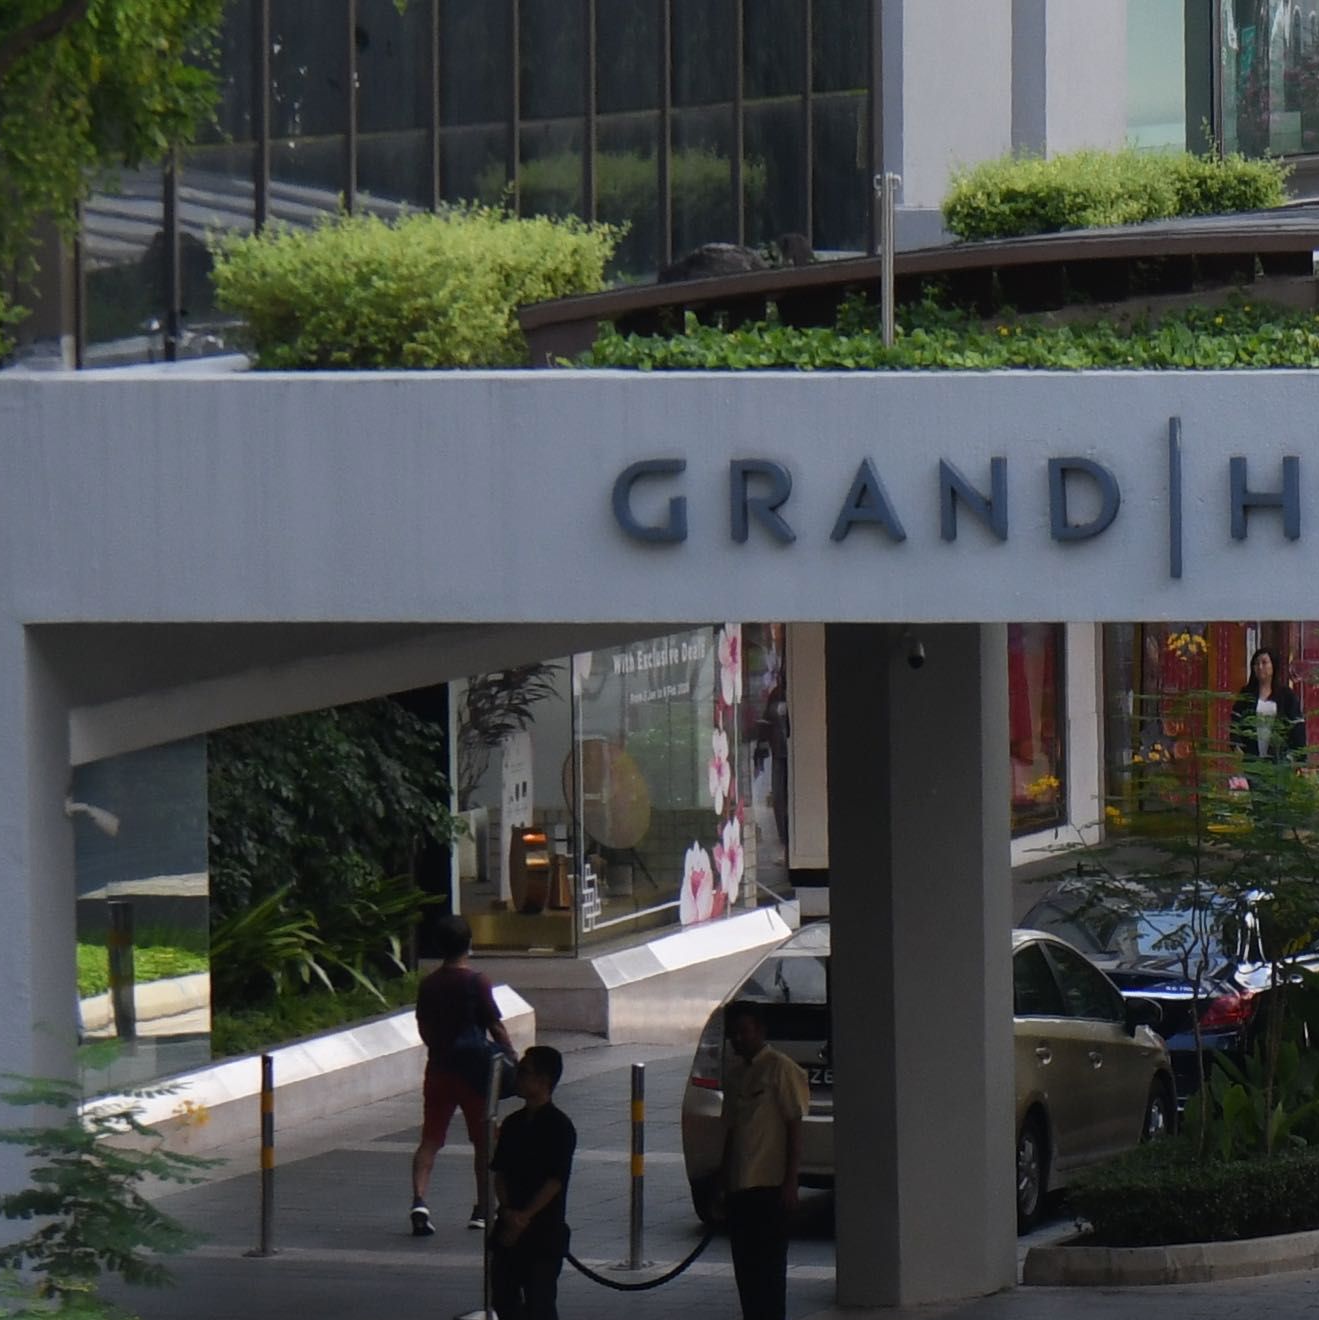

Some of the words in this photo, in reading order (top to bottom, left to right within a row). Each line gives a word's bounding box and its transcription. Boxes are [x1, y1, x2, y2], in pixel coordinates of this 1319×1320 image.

[612, 457, 1121, 543] GRAND
[613, 652, 635, 673] With
[637, 647, 679, 670] Exclusive
